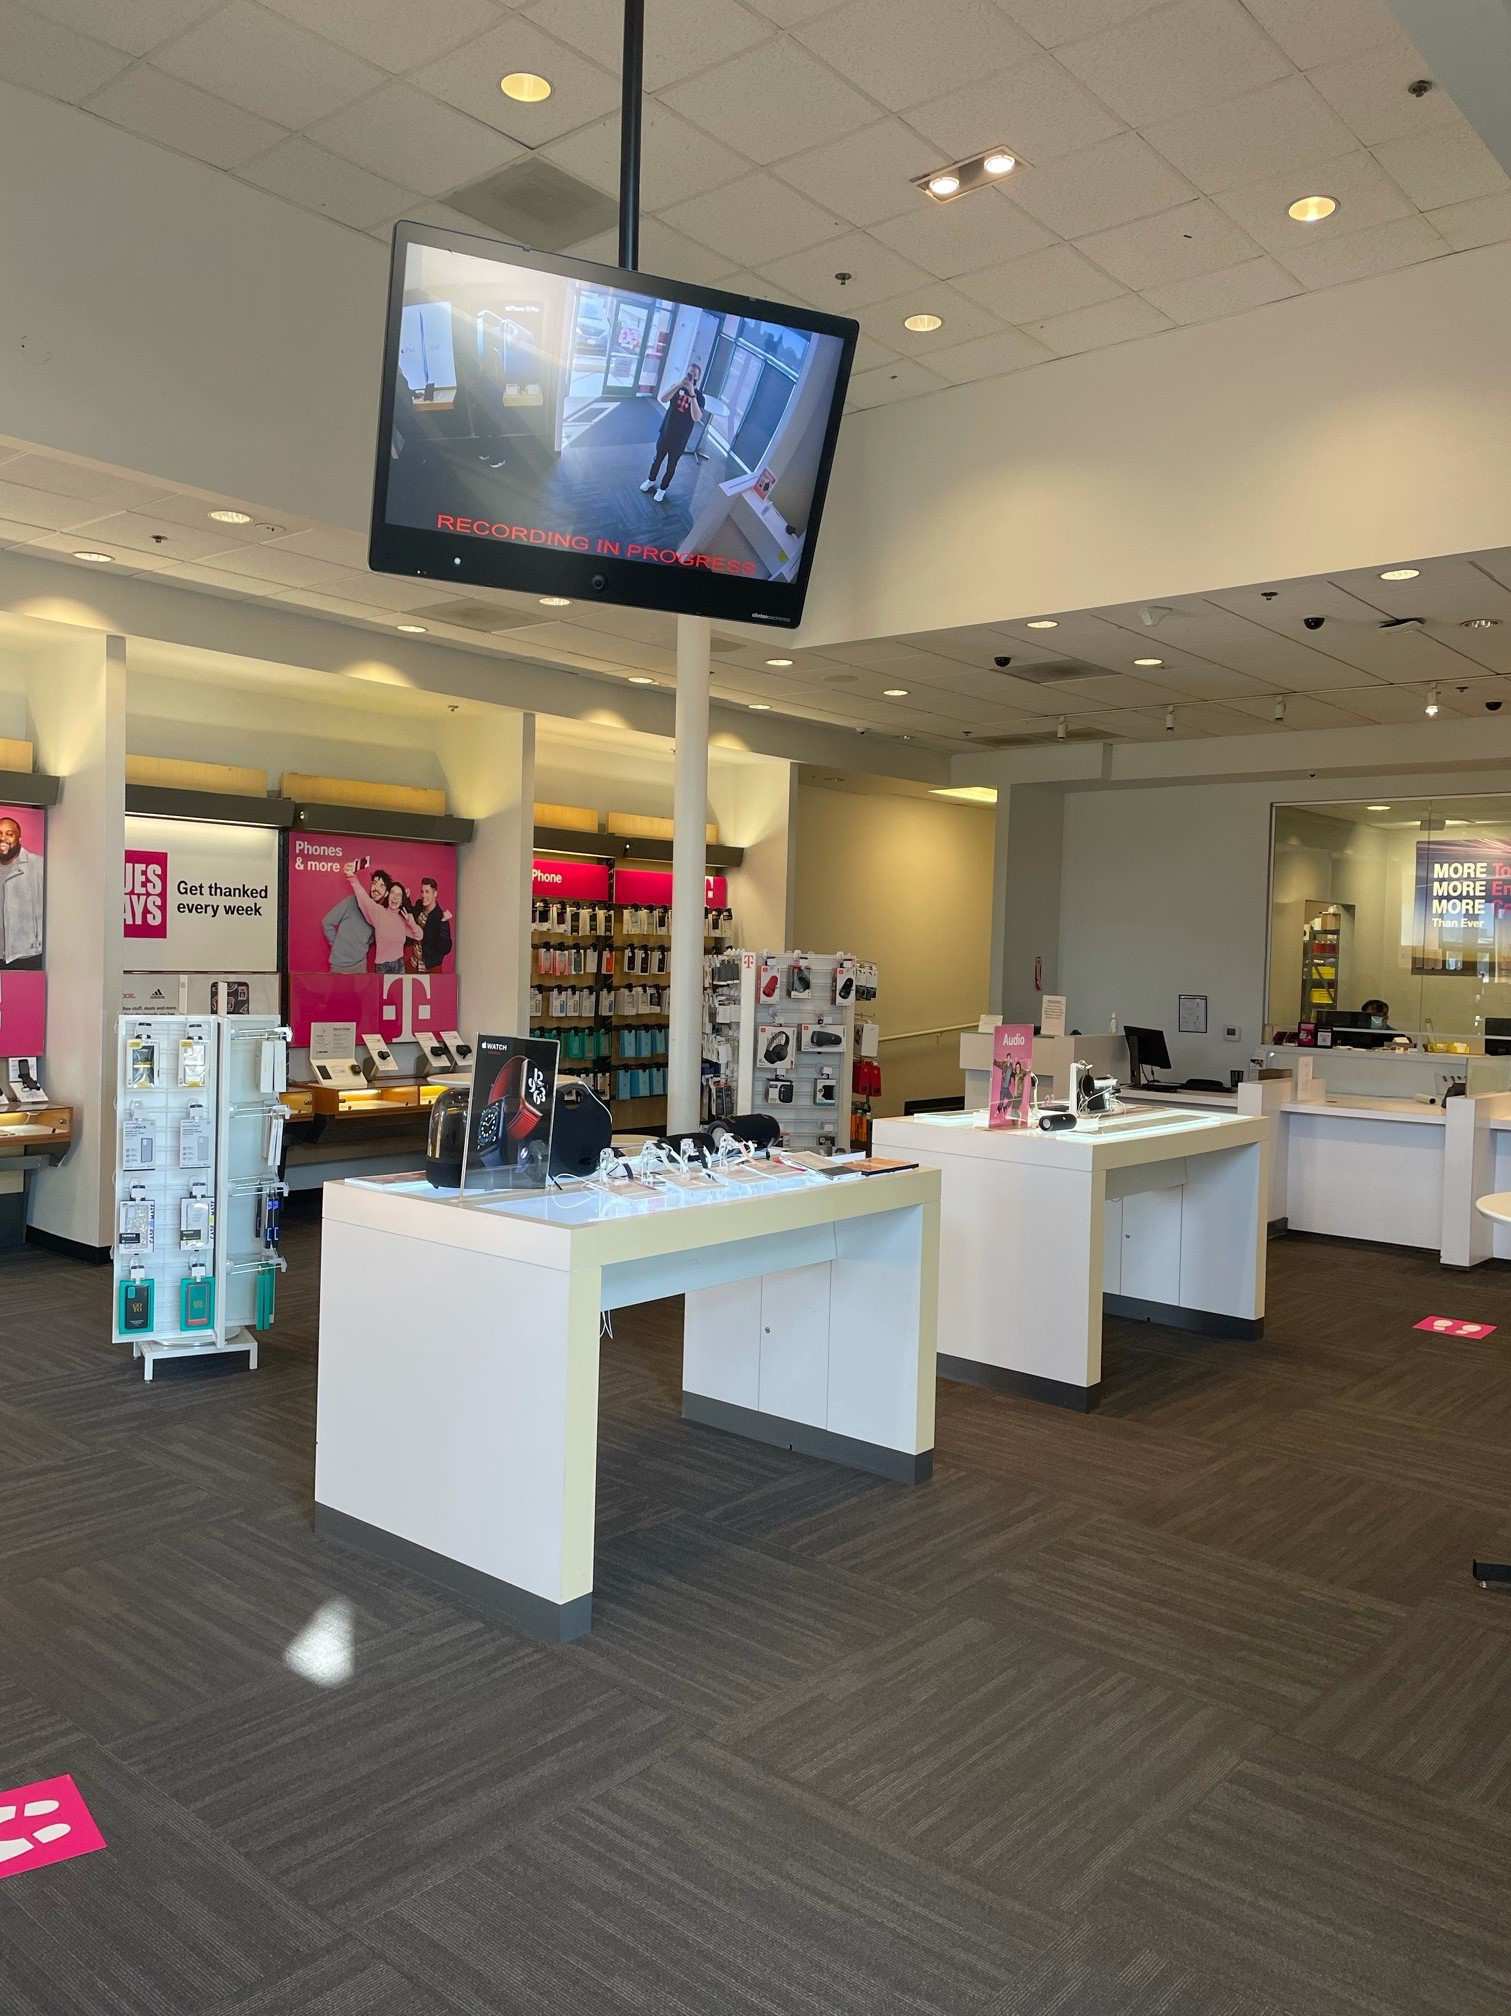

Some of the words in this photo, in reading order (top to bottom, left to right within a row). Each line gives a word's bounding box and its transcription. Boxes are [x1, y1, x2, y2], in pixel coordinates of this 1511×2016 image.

[437, 513, 589, 550] RECORDING
[596, 538, 620, 556] IN
[626, 543, 757, 576] PROGRESS
[295, 840, 343, 857] Phones
[295, 857, 304, 871] &
[307, 860, 341, 873] more
[1433, 862, 1488, 879] MORE
[176, 880, 204, 897] Get
[208, 882, 269, 900] thanked
[1432, 880, 1487, 897] MORE
[176, 902, 220, 918] every
[224, 902, 263, 917] week
[1431, 898, 1486, 915] MORE
[1431, 917, 1458, 928] Than
[1461, 917, 1485, 928] Ever
[486, 1042, 508, 1052] WATCH
[1002, 1033, 1025, 1047] Audio
